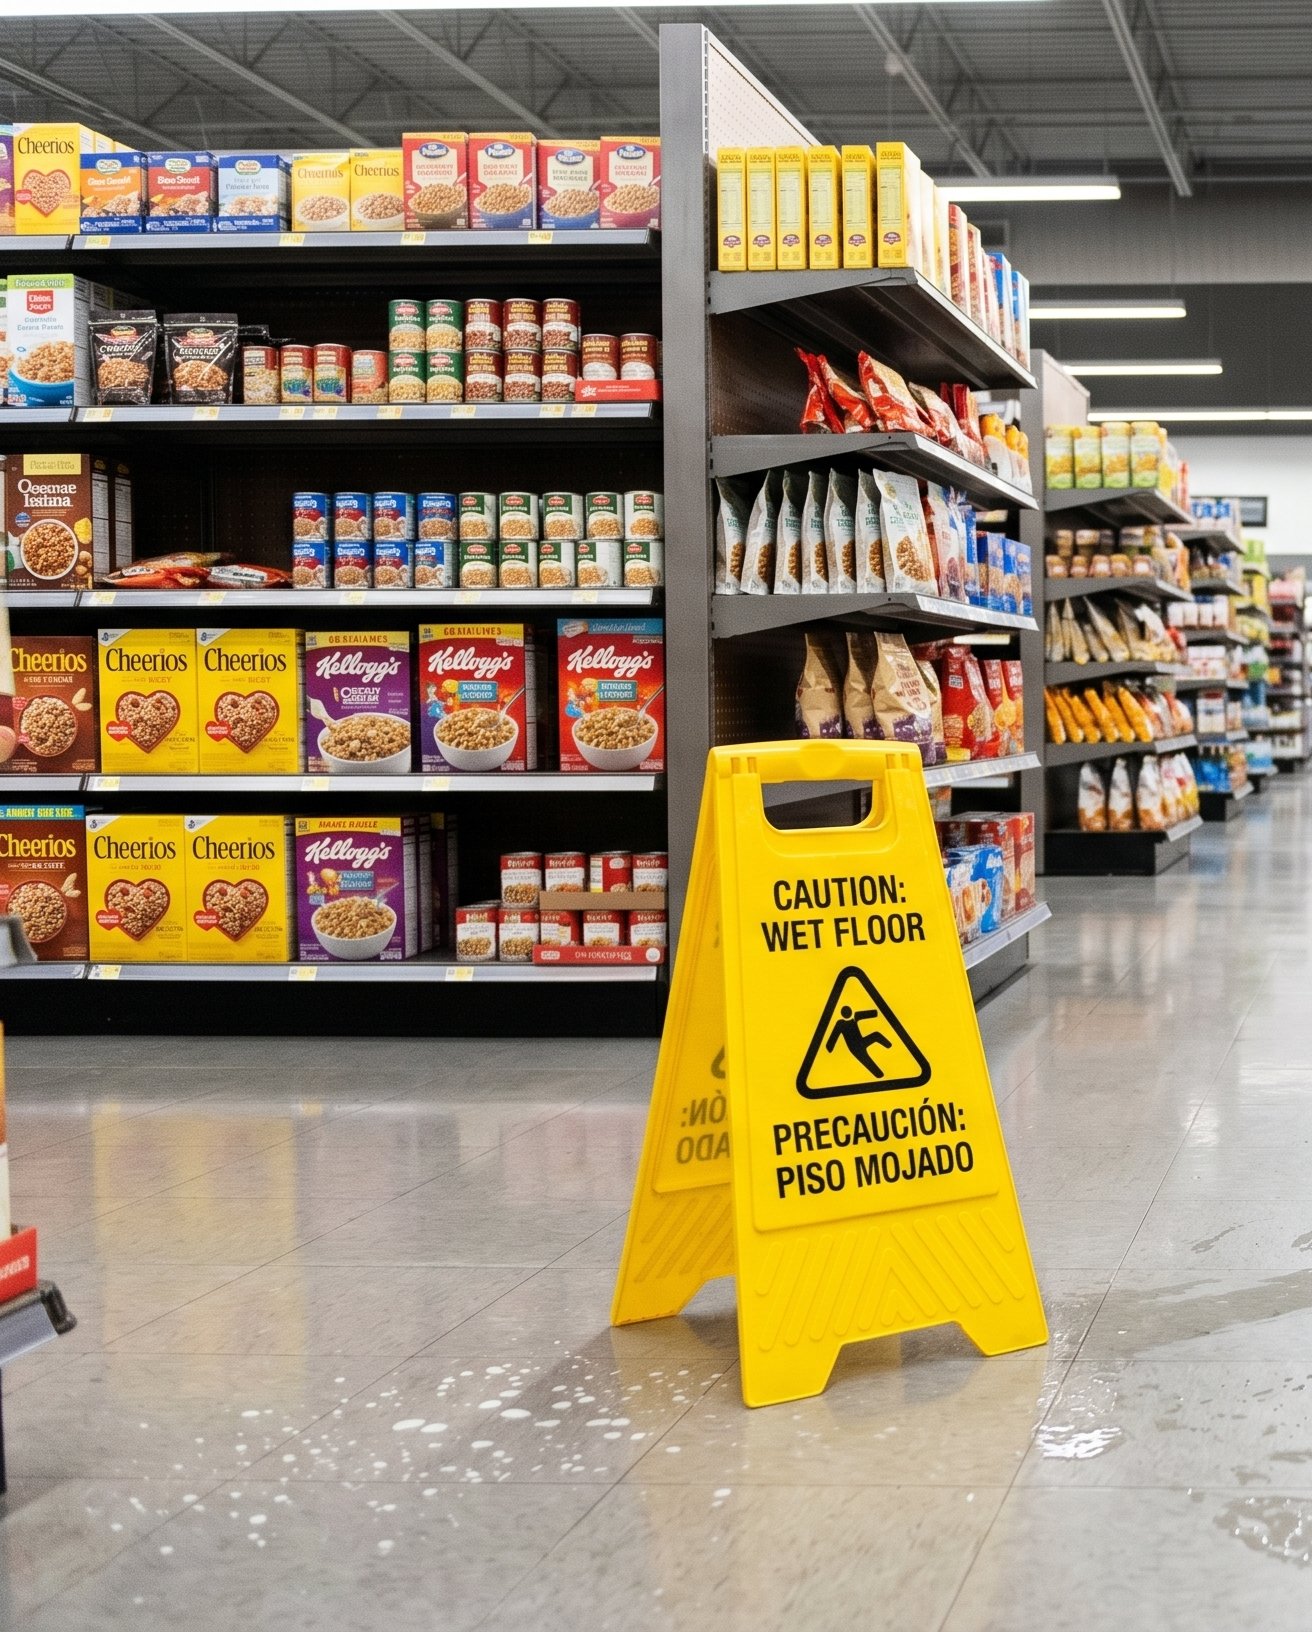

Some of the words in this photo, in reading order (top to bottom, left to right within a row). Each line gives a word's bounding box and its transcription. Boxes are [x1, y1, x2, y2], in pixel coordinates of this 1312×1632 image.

[17, 136, 75, 155] Cheerios
[105, 648, 188, 672] Cheerios
[204, 647, 287, 672] Cheerios
[315, 651, 401, 683] Kellogg's
[427, 646, 514, 679] Kellogg's
[566, 645, 655, 678] Kellogg's
[93, 835, 177, 860] Cheerios
[192, 835, 275, 860] Cheerios
[304, 836, 392, 869] Kellogg's
[773, 874, 907, 911] CAUTION:
[760, 917, 825, 953] WET
[833, 912, 926, 948] FLOOR
[772, 1097, 967, 1156] PRECAUCIÓN:
[776, 1158, 846, 1199] PISO
[854, 1141, 974, 1188] MOJADO
